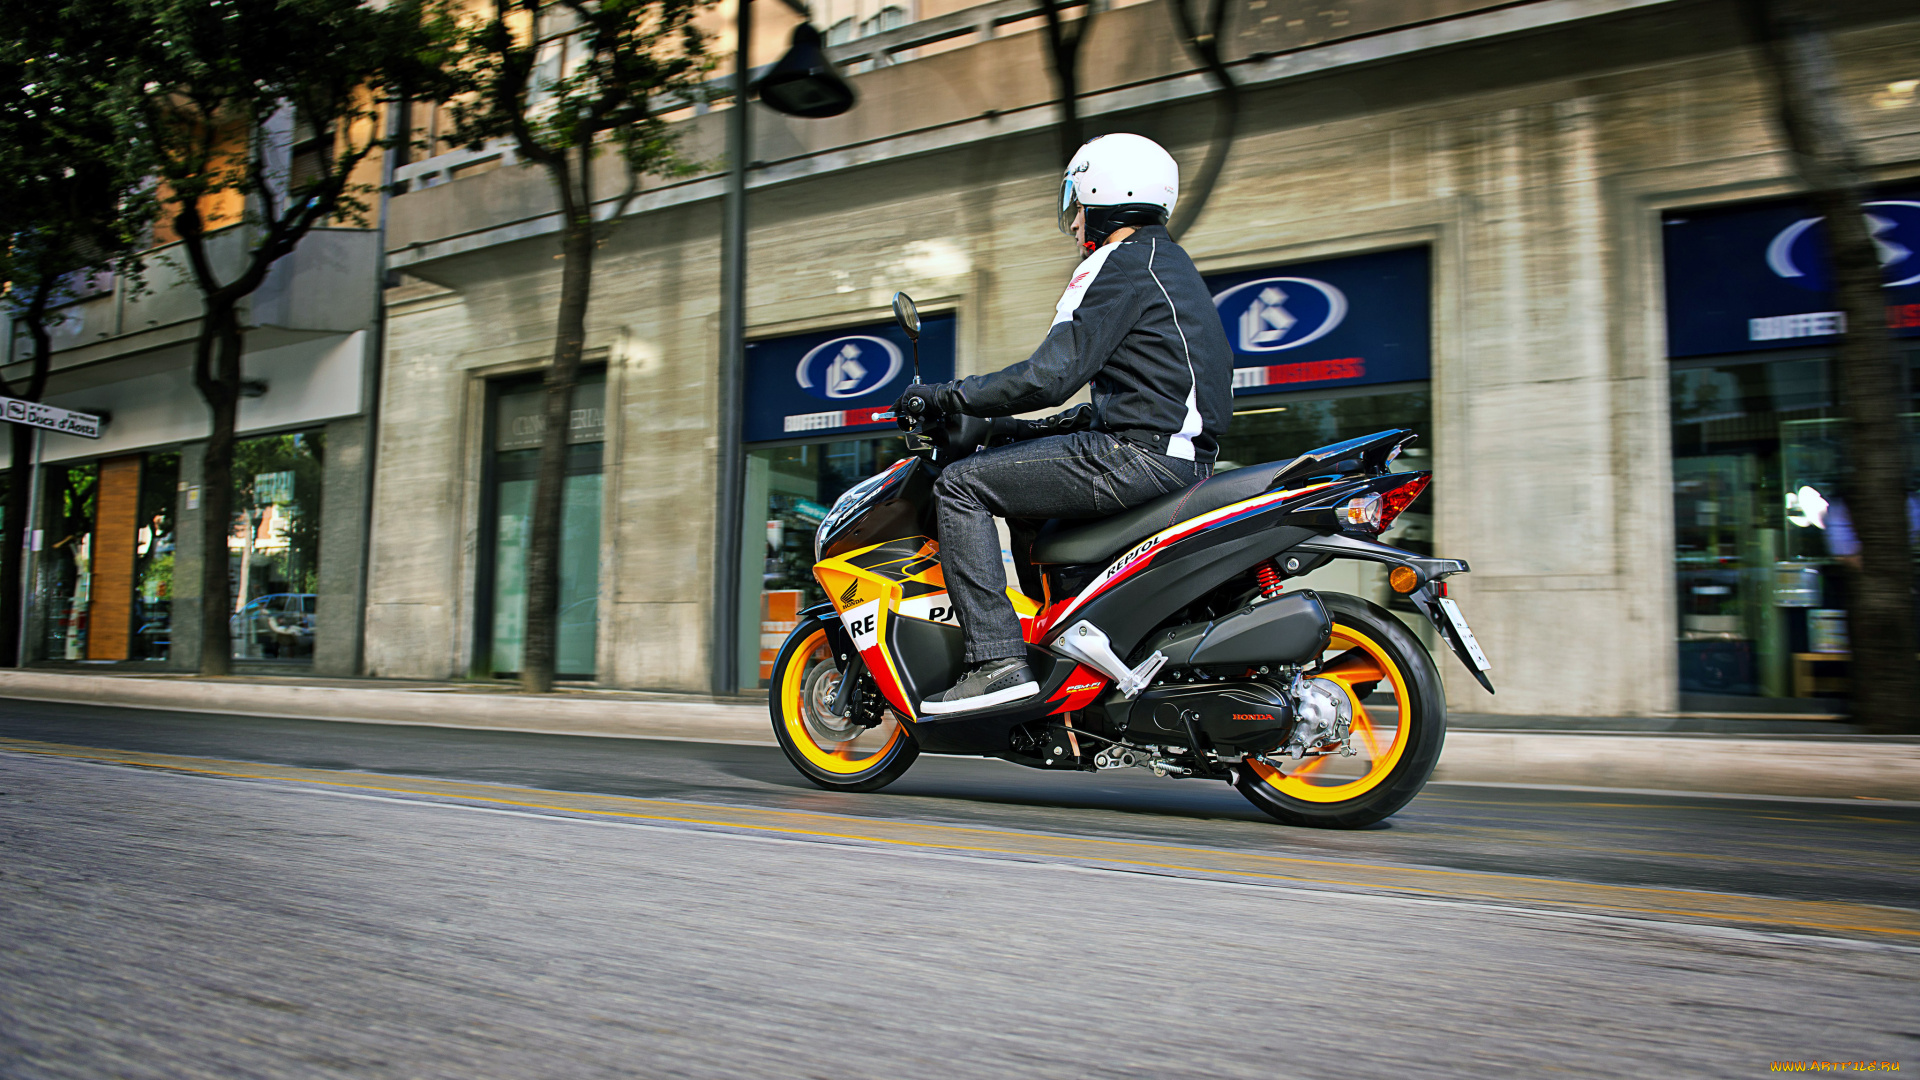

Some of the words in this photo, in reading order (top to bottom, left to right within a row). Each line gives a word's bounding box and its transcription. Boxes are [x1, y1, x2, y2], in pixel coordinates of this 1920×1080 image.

[28, 411, 55, 427] Duca
[58, 418, 97, 435] d'Aosta
[1106, 536, 1161, 579] REPSOL
[842, 597, 865, 610] HONDA
[850, 614, 875, 638] RE
[1232, 713, 1276, 721] HONDA
